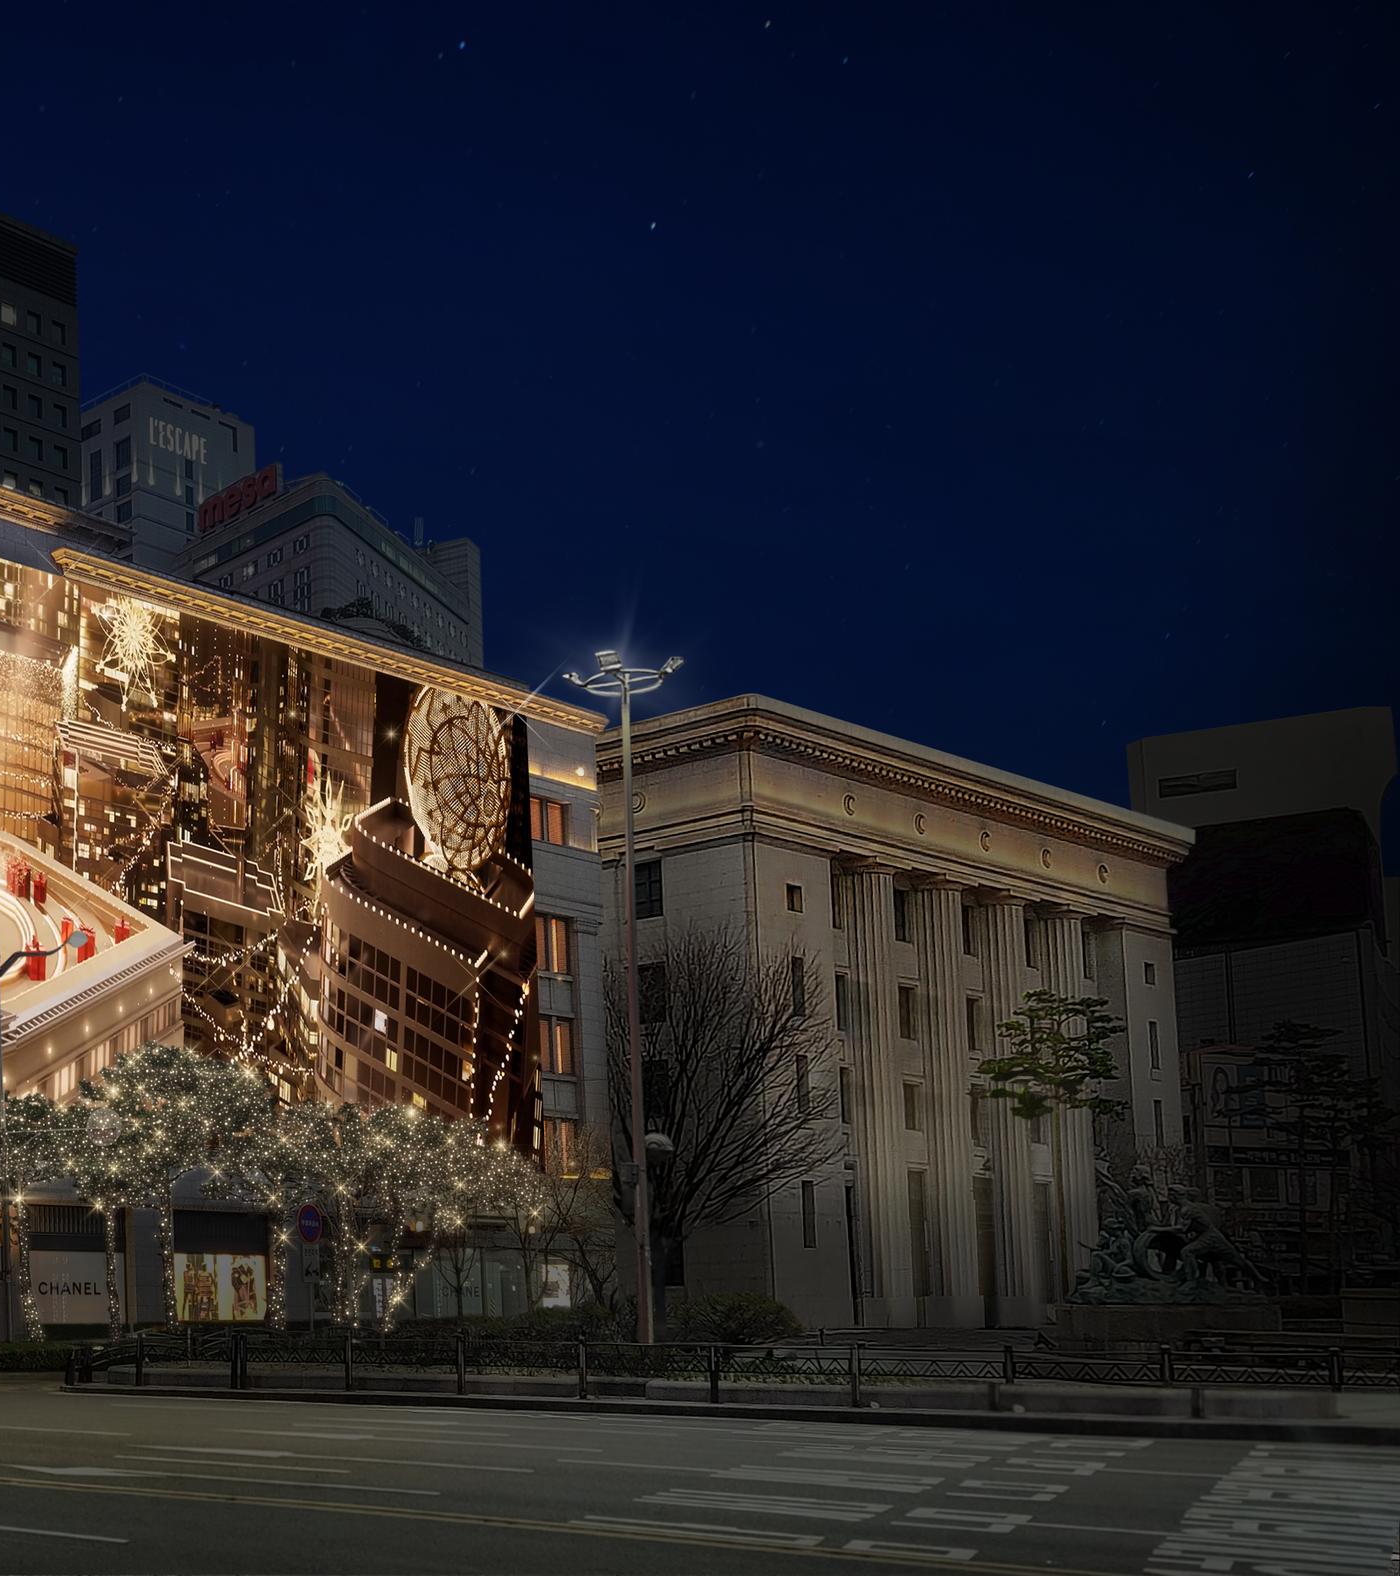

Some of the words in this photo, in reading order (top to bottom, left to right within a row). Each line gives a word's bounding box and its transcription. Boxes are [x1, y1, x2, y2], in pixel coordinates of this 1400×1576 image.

[148, 415, 208, 465] L'ESCAPE
[198, 463, 278, 532] mesa
[38, 1281, 102, 1295] CHANEL
